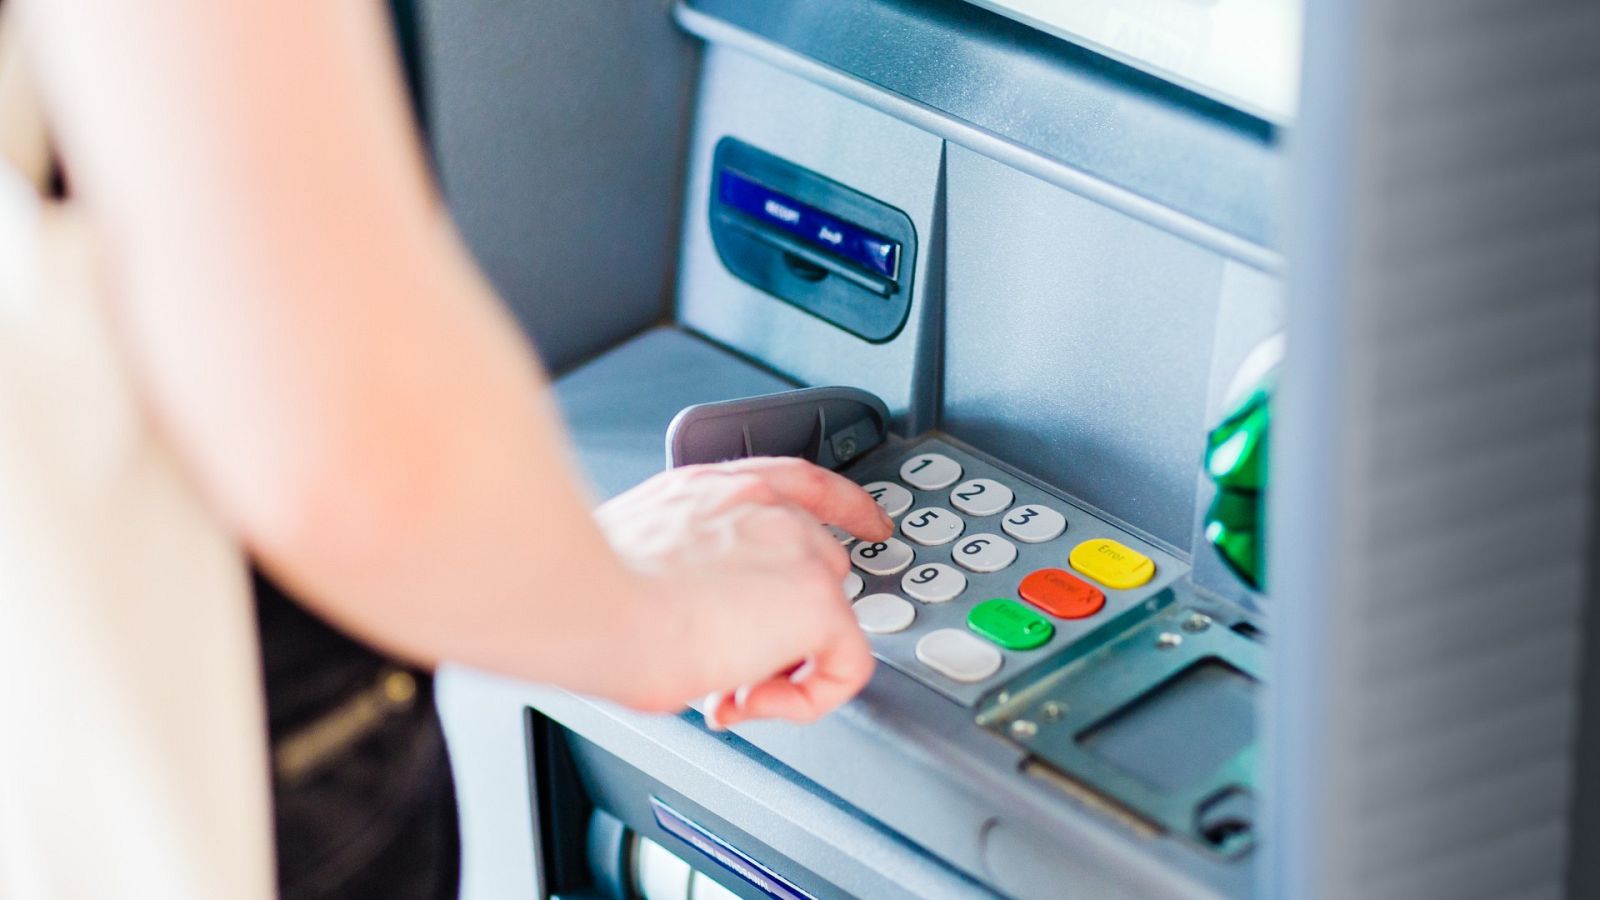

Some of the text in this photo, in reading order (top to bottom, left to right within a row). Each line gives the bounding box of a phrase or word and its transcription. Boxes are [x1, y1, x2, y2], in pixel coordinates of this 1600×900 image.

[910, 459, 933, 474] 1
[957, 484, 986, 501] 2
[908, 510, 939, 528] 5
[1008, 508, 1039, 525] 3
[859, 541, 888, 558] 8
[962, 539, 990, 555] 6
[1097, 544, 1125, 561] Error
[910, 567, 939, 584] 9
